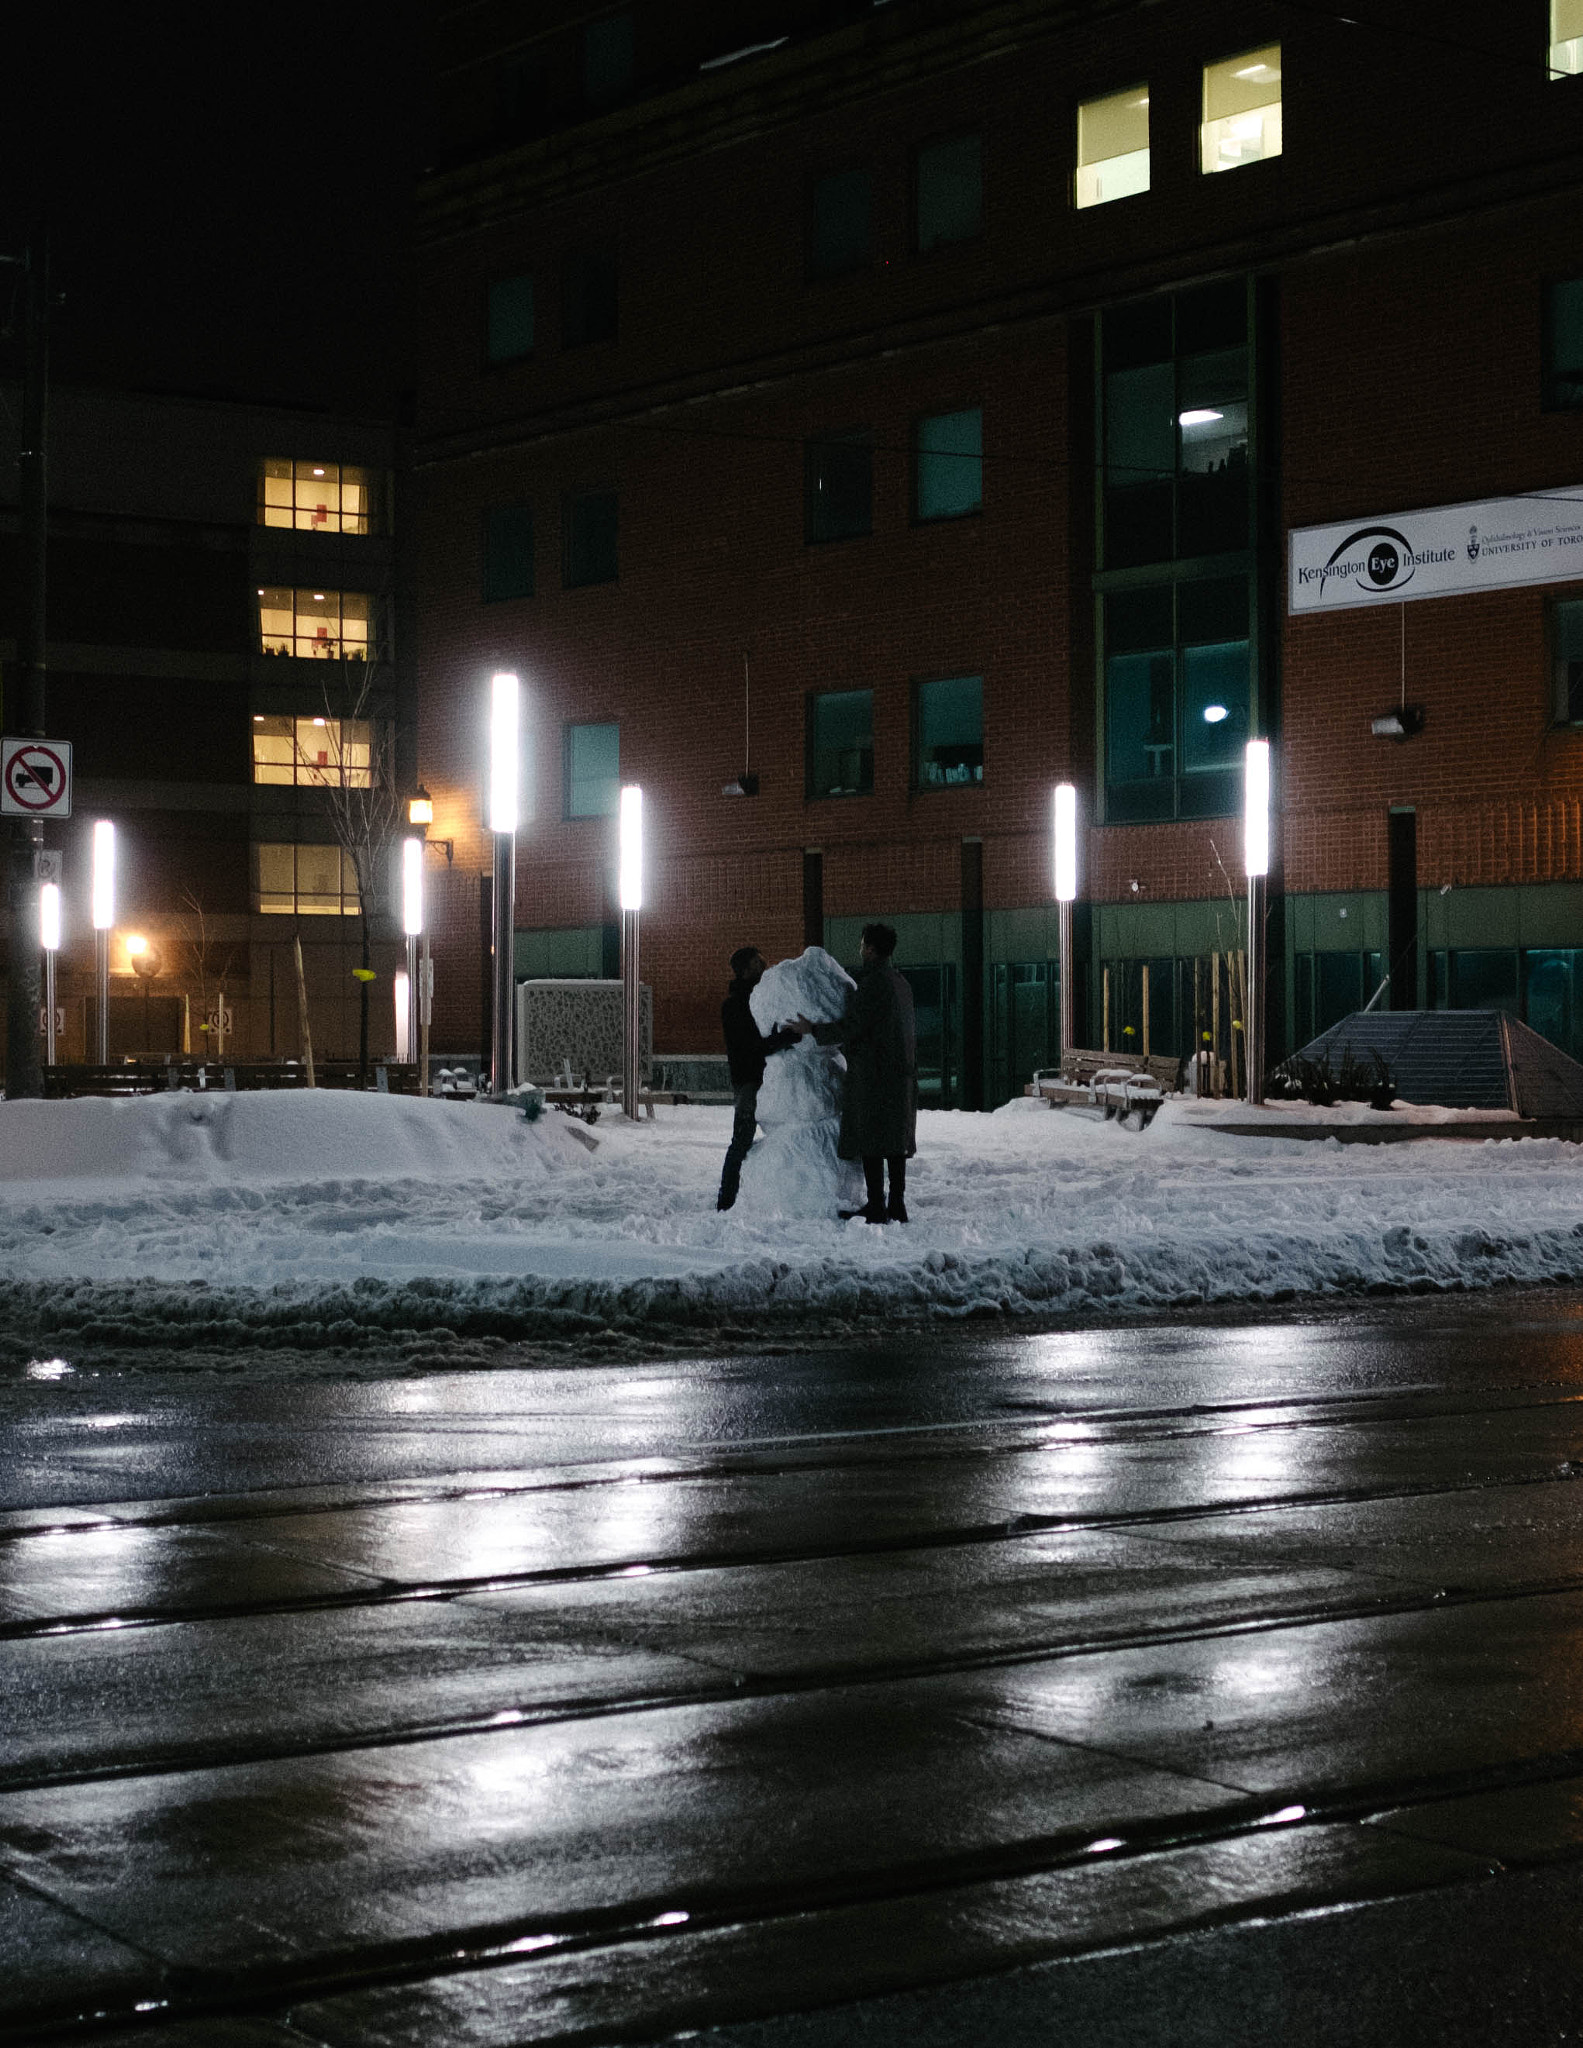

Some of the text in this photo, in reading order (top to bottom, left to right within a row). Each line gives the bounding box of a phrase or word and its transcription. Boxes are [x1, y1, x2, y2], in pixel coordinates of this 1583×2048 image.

[1482, 541, 1537, 556] UNIVERSITY
[1541, 538, 1554, 547] OF
[1298, 548, 1456, 584] Kensington Eye Institute
